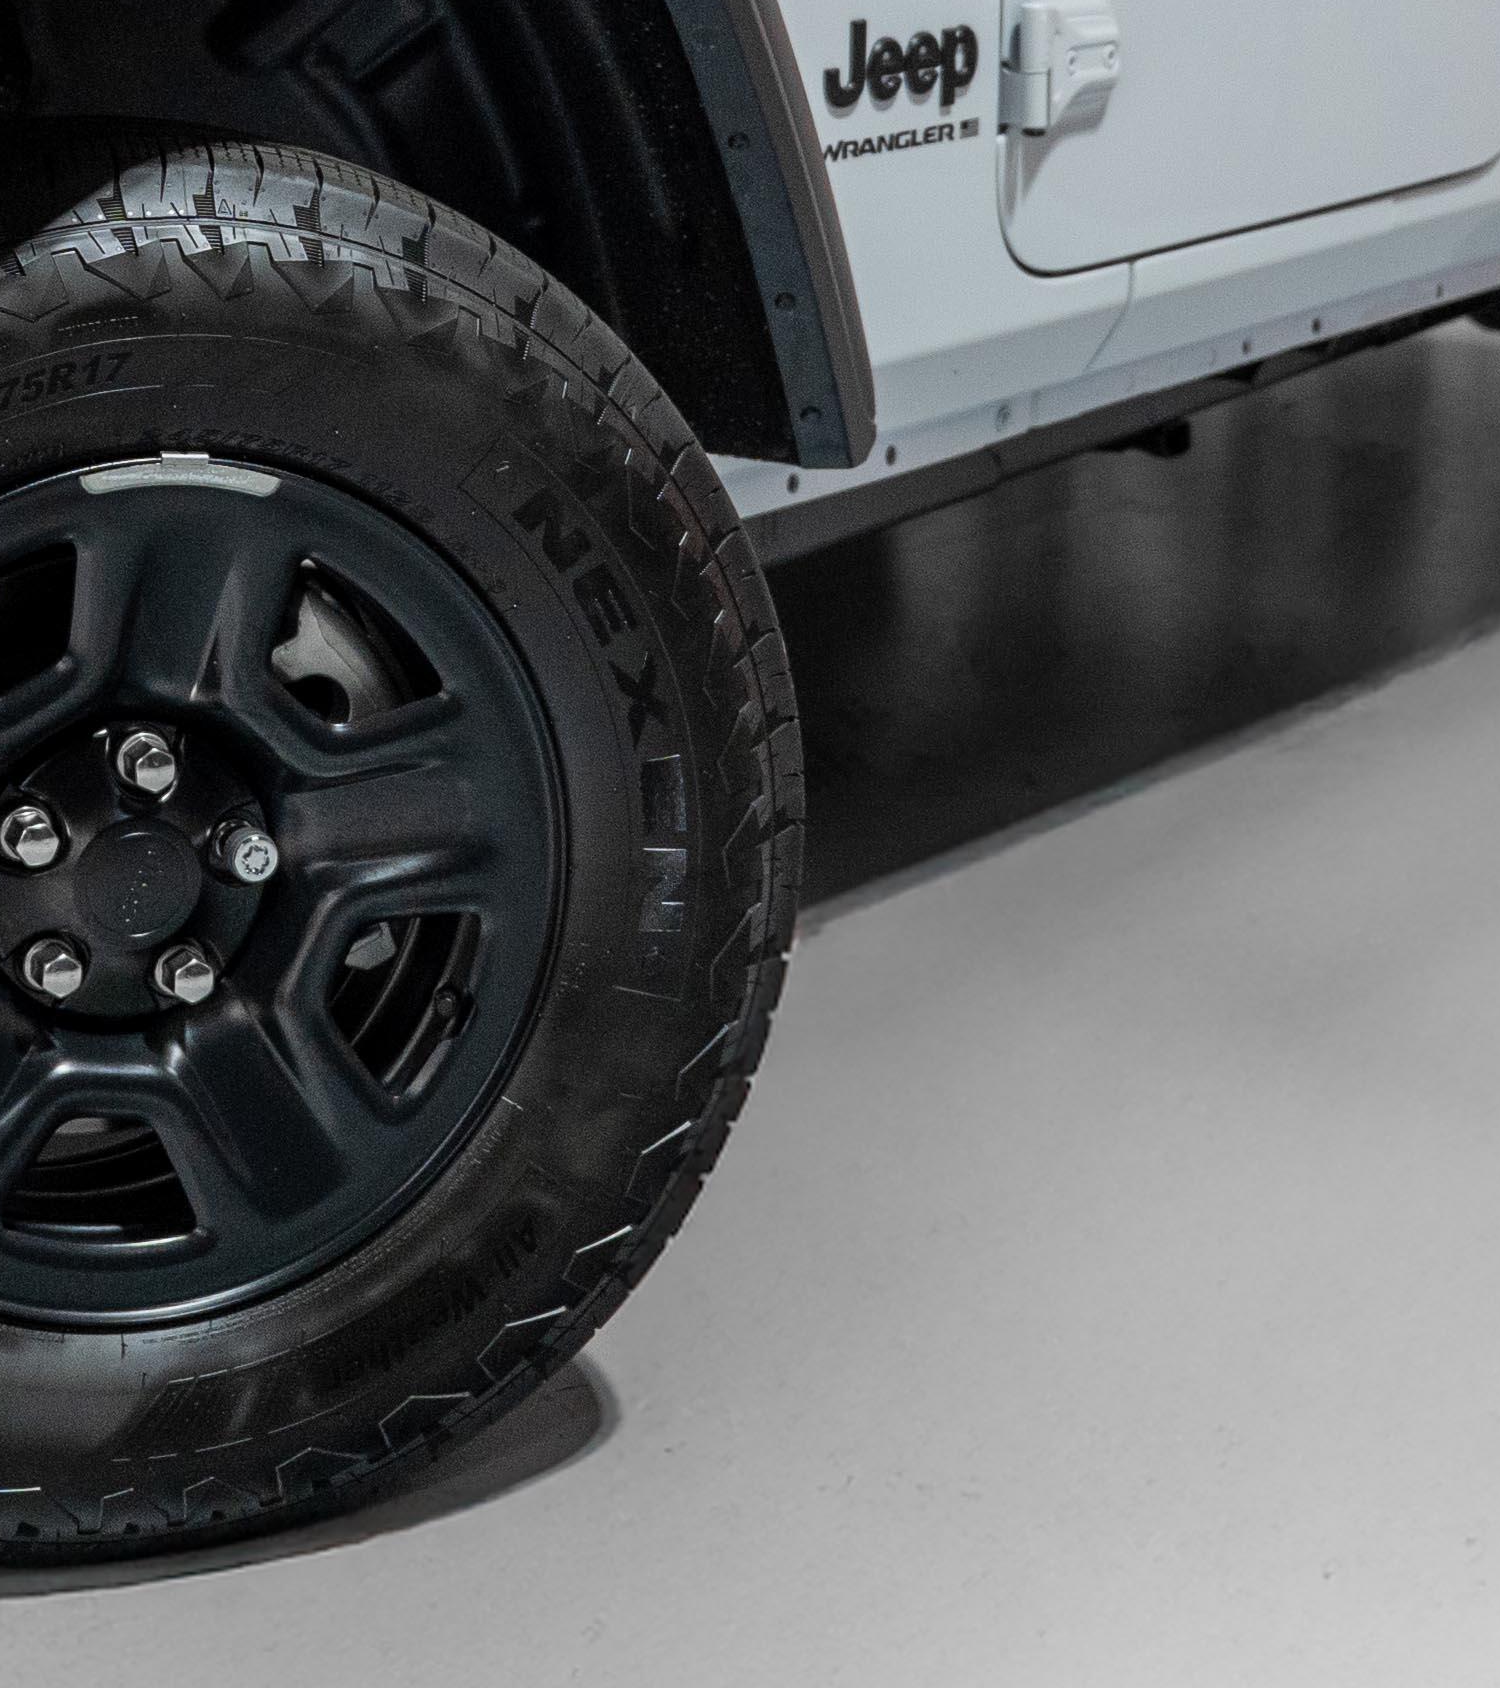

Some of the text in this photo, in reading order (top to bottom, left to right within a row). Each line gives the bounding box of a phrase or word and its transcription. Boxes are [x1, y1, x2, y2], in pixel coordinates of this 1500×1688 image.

[823, 18, 978, 108] Jeep
[823, 122, 954, 162] WRANGLER
[511, 487, 689, 935] NEXEN
